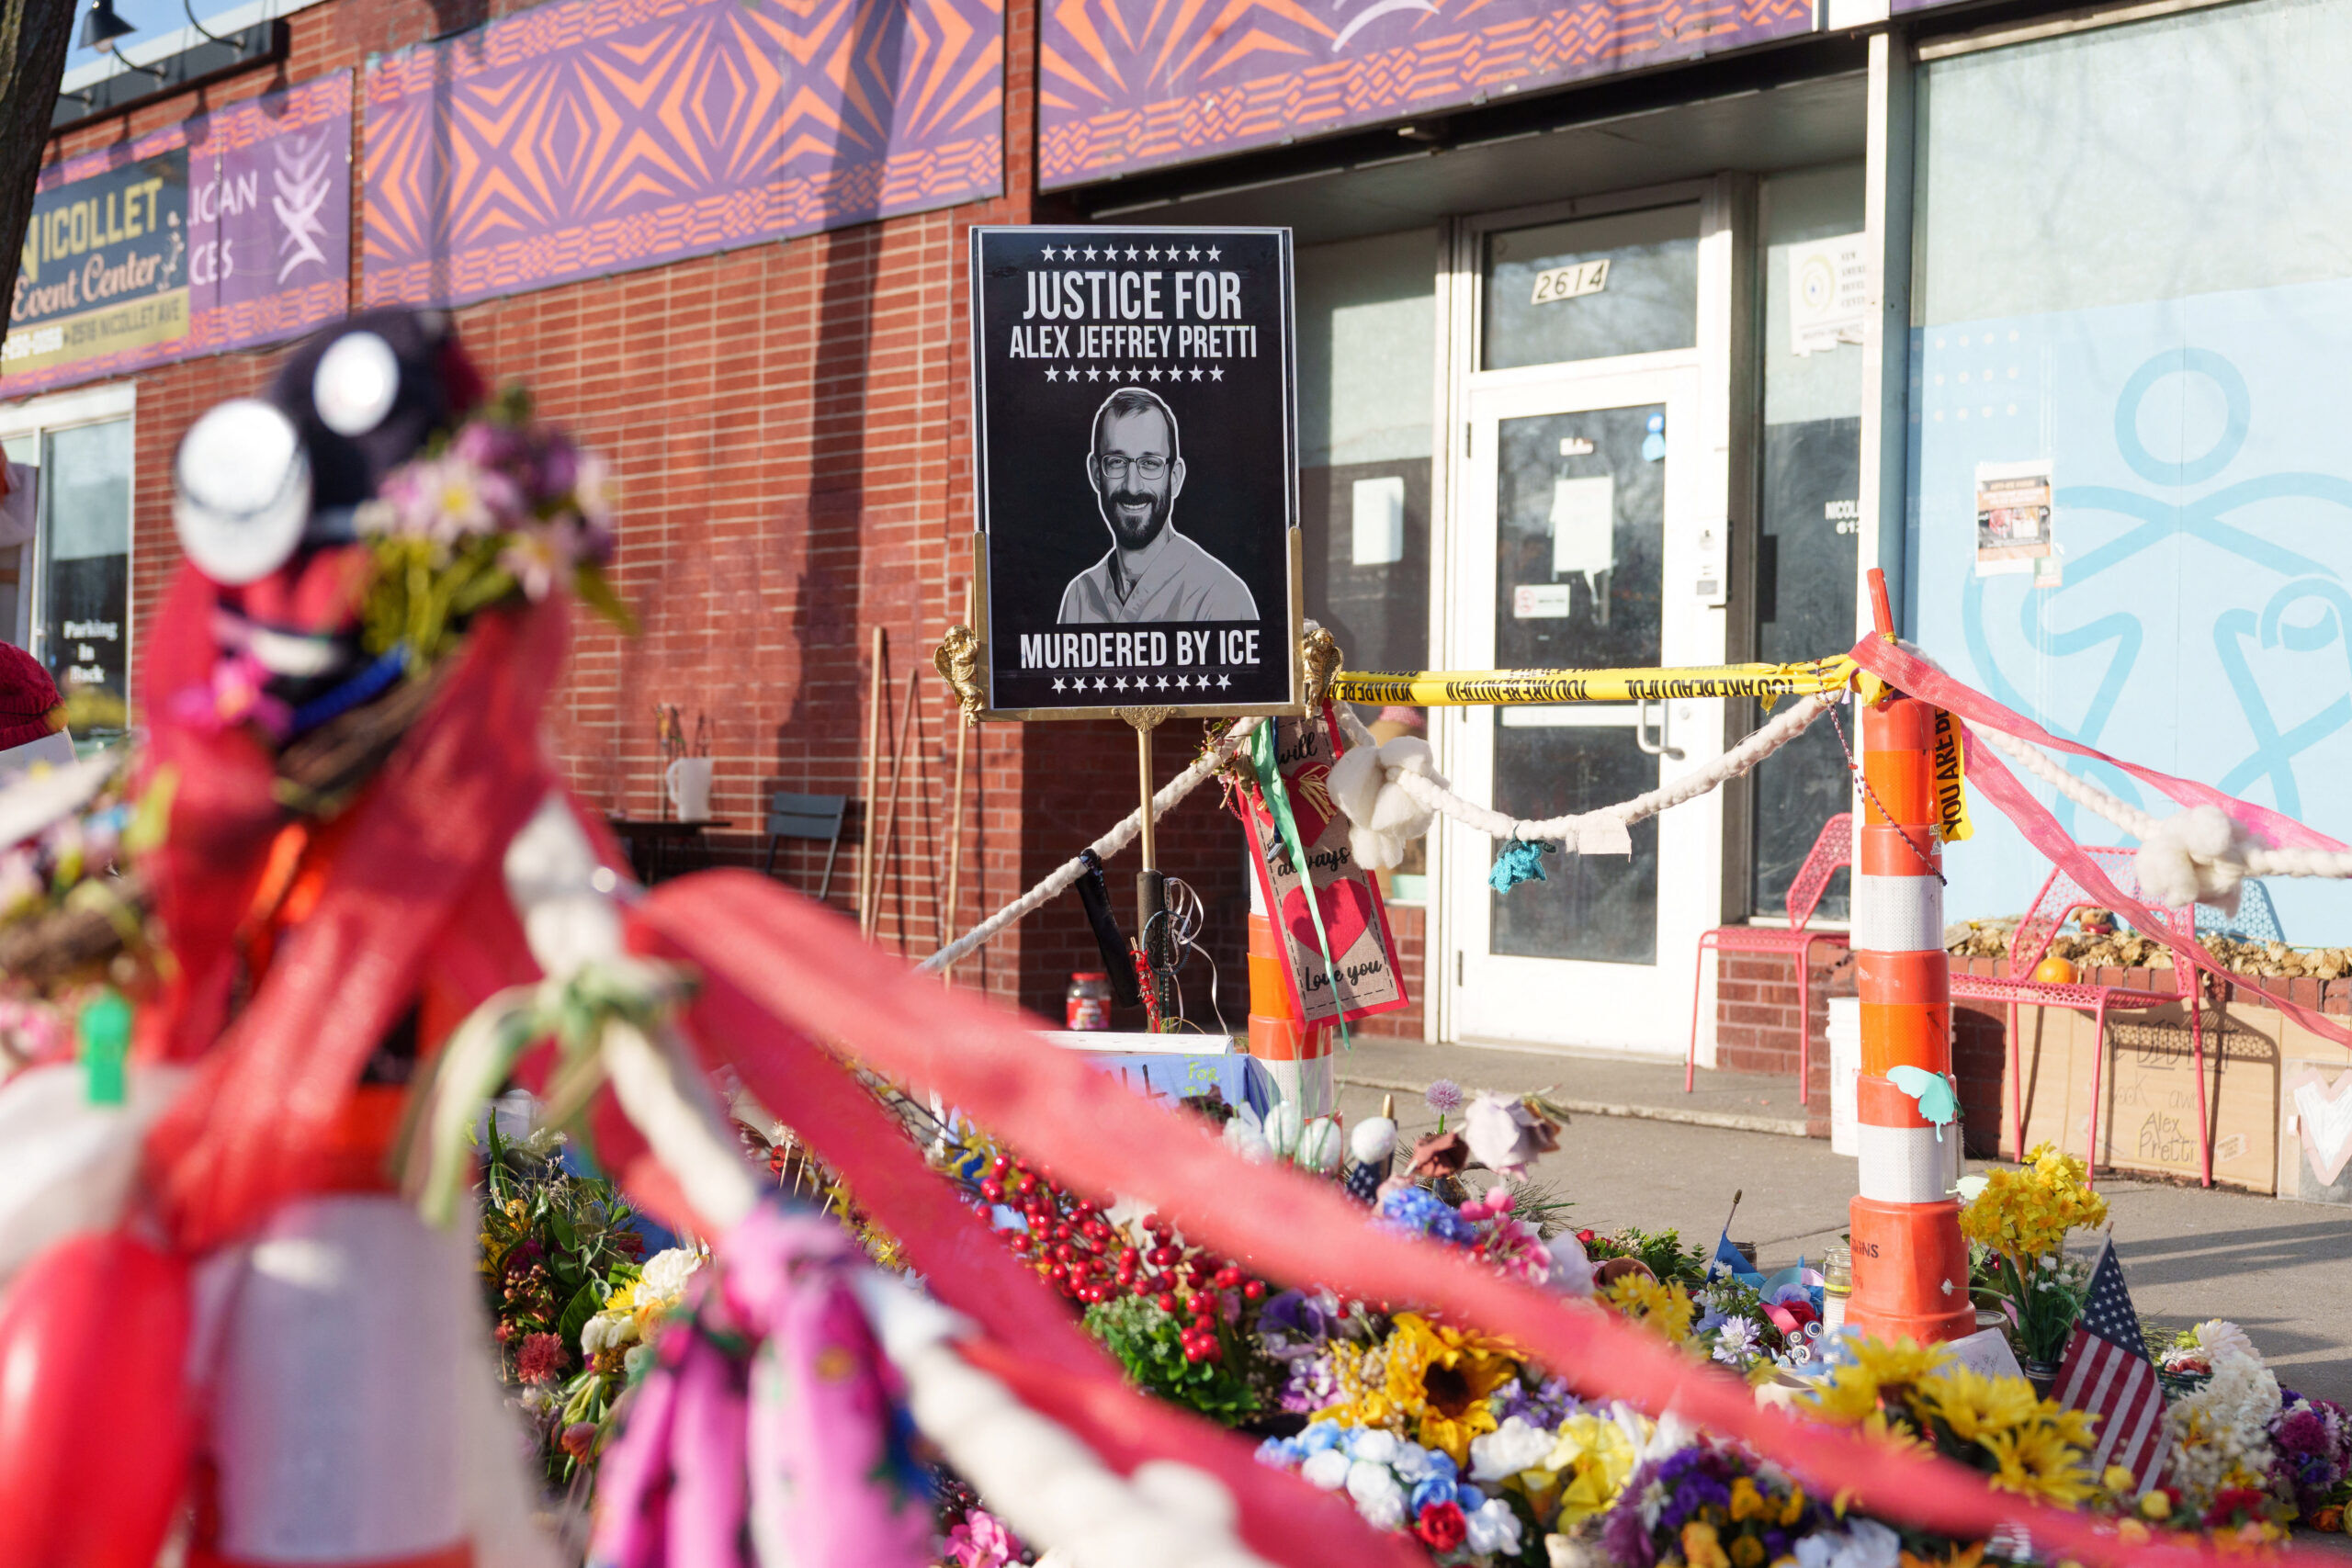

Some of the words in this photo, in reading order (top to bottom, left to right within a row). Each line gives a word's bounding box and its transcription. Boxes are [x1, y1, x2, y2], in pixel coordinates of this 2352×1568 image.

[21, 177, 164, 284] NICOLLET
[11, 268, 80, 321] Event
[82, 251, 162, 302] Center
[1023, 271, 1163, 320] JUSTICE
[1175, 271, 1241, 320] FOR
[1537, 263, 1604, 299] 2614
[1010, 325, 1071, 358] ALEX
[1077, 325, 1172, 358] JEFFREY
[1179, 325, 1257, 358] PRETTI
[63, 618, 119, 641] Parking
[1020, 632, 1167, 669] MURDERED
[1176, 631, 1211, 666] BY
[1219, 629, 1261, 665] ICE
[70, 664, 105, 683] Back
[1555, 679, 1594, 701] YOU
[1936, 734, 1959, 780] ARE
[1939, 784, 1962, 835] YOU
[1347, 960, 1383, 986] you
[2137, 1019, 2181, 1066] DID
[1188, 1061, 1220, 1082] FOR
[2142, 1111, 2182, 1140] Alex
[2139, 1129, 2196, 1163] Pretti
